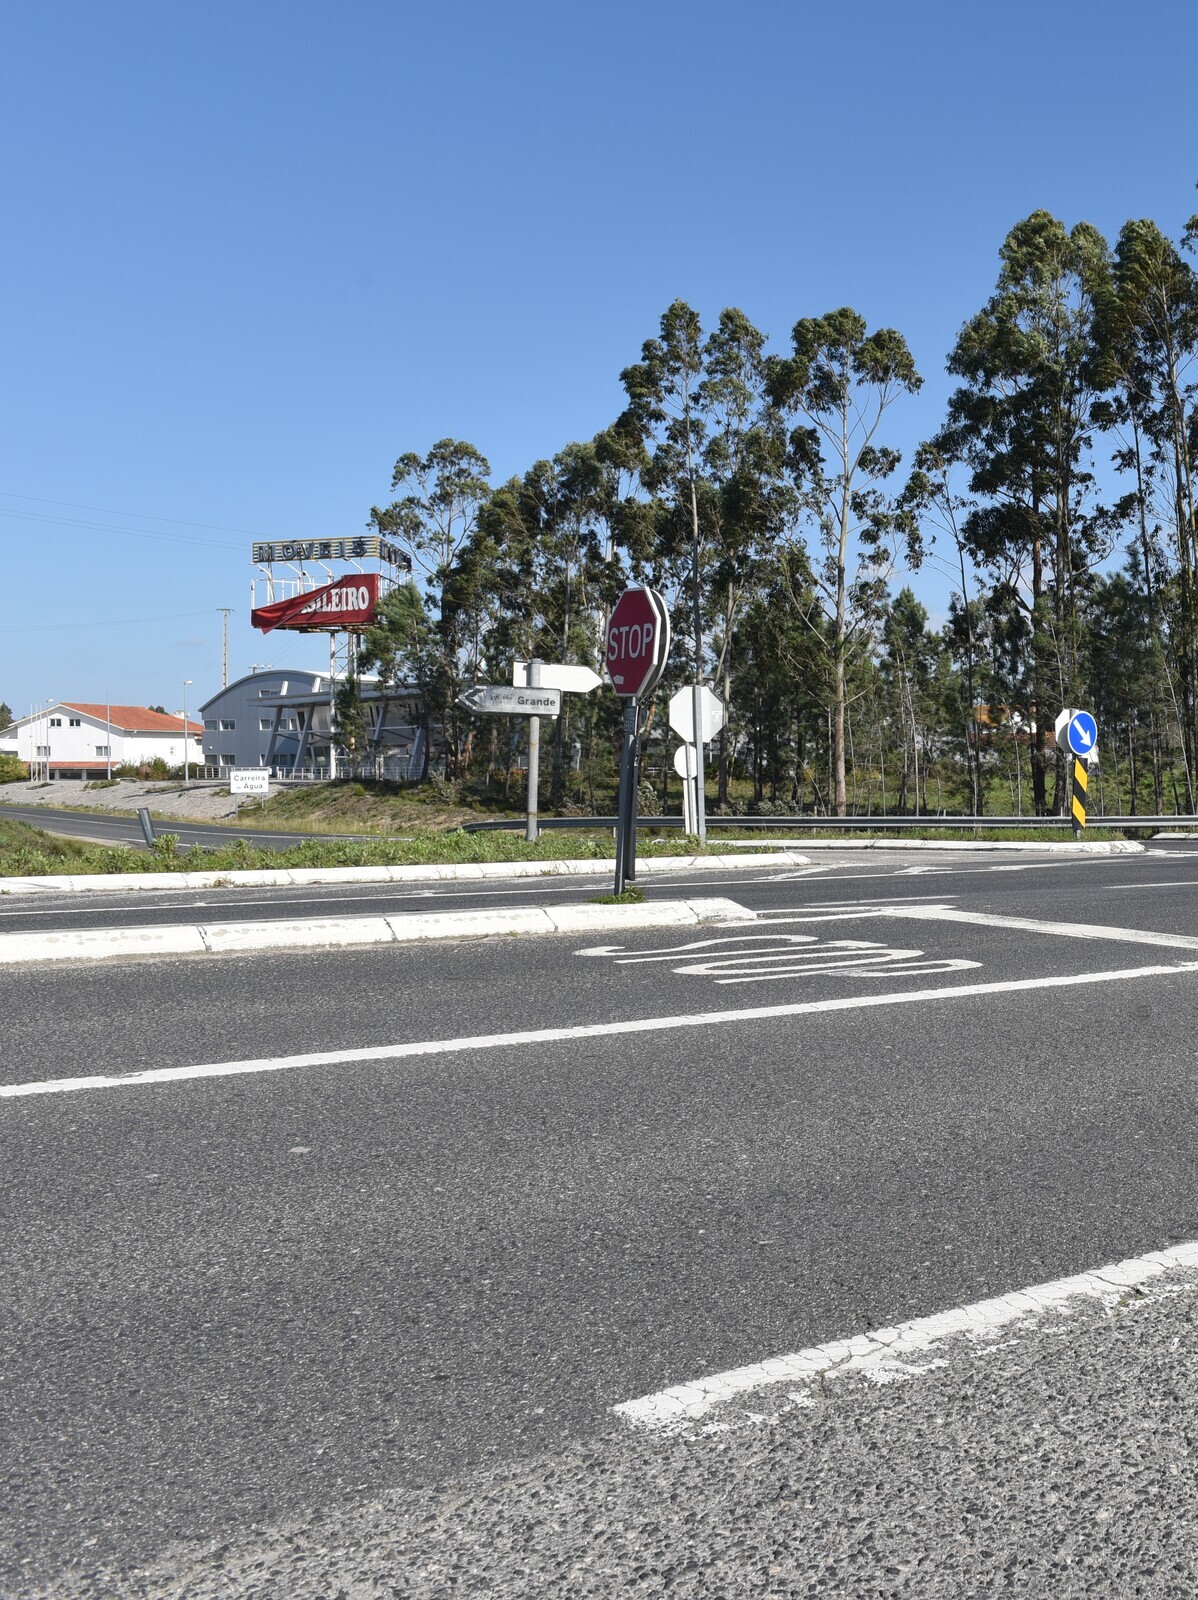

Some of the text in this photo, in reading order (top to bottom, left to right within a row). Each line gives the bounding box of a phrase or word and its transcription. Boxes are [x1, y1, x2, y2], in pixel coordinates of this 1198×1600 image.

[258, 540, 367, 561] MÓVEIS
[608, 623, 653, 660] STOP
[517, 696, 556, 707] Grande
